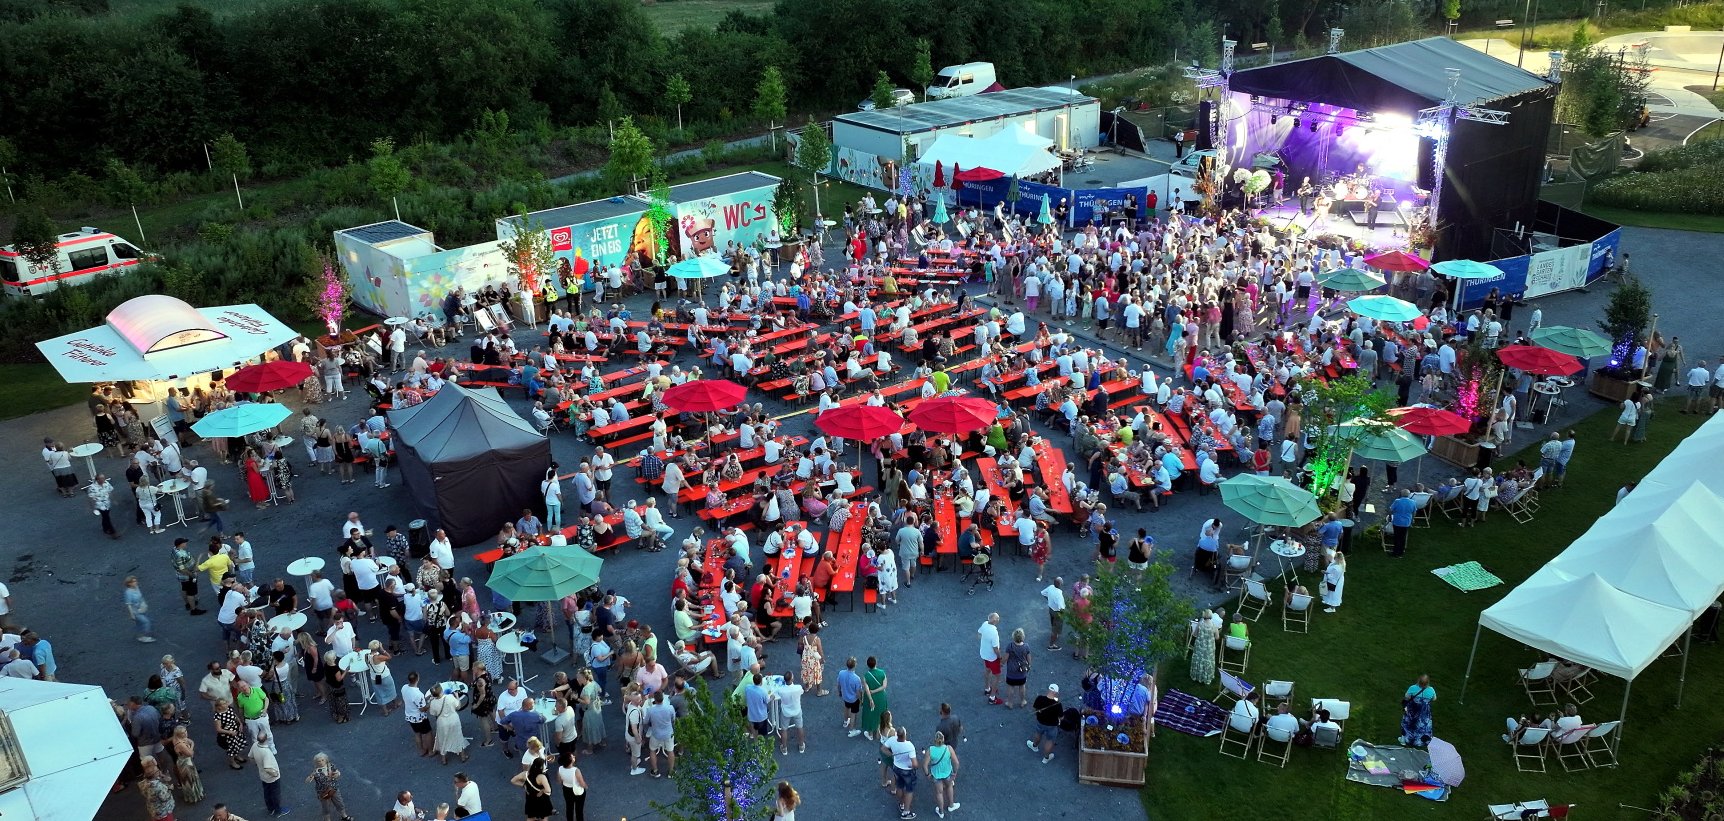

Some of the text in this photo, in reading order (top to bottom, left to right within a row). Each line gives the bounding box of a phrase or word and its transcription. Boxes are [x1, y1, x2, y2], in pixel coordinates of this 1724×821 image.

[1079, 199, 1123, 208] THÜGEN
[723, 202, 752, 231] WC
[590, 223, 619, 243] JETZT
[592, 239, 625, 258] EIN EIS
